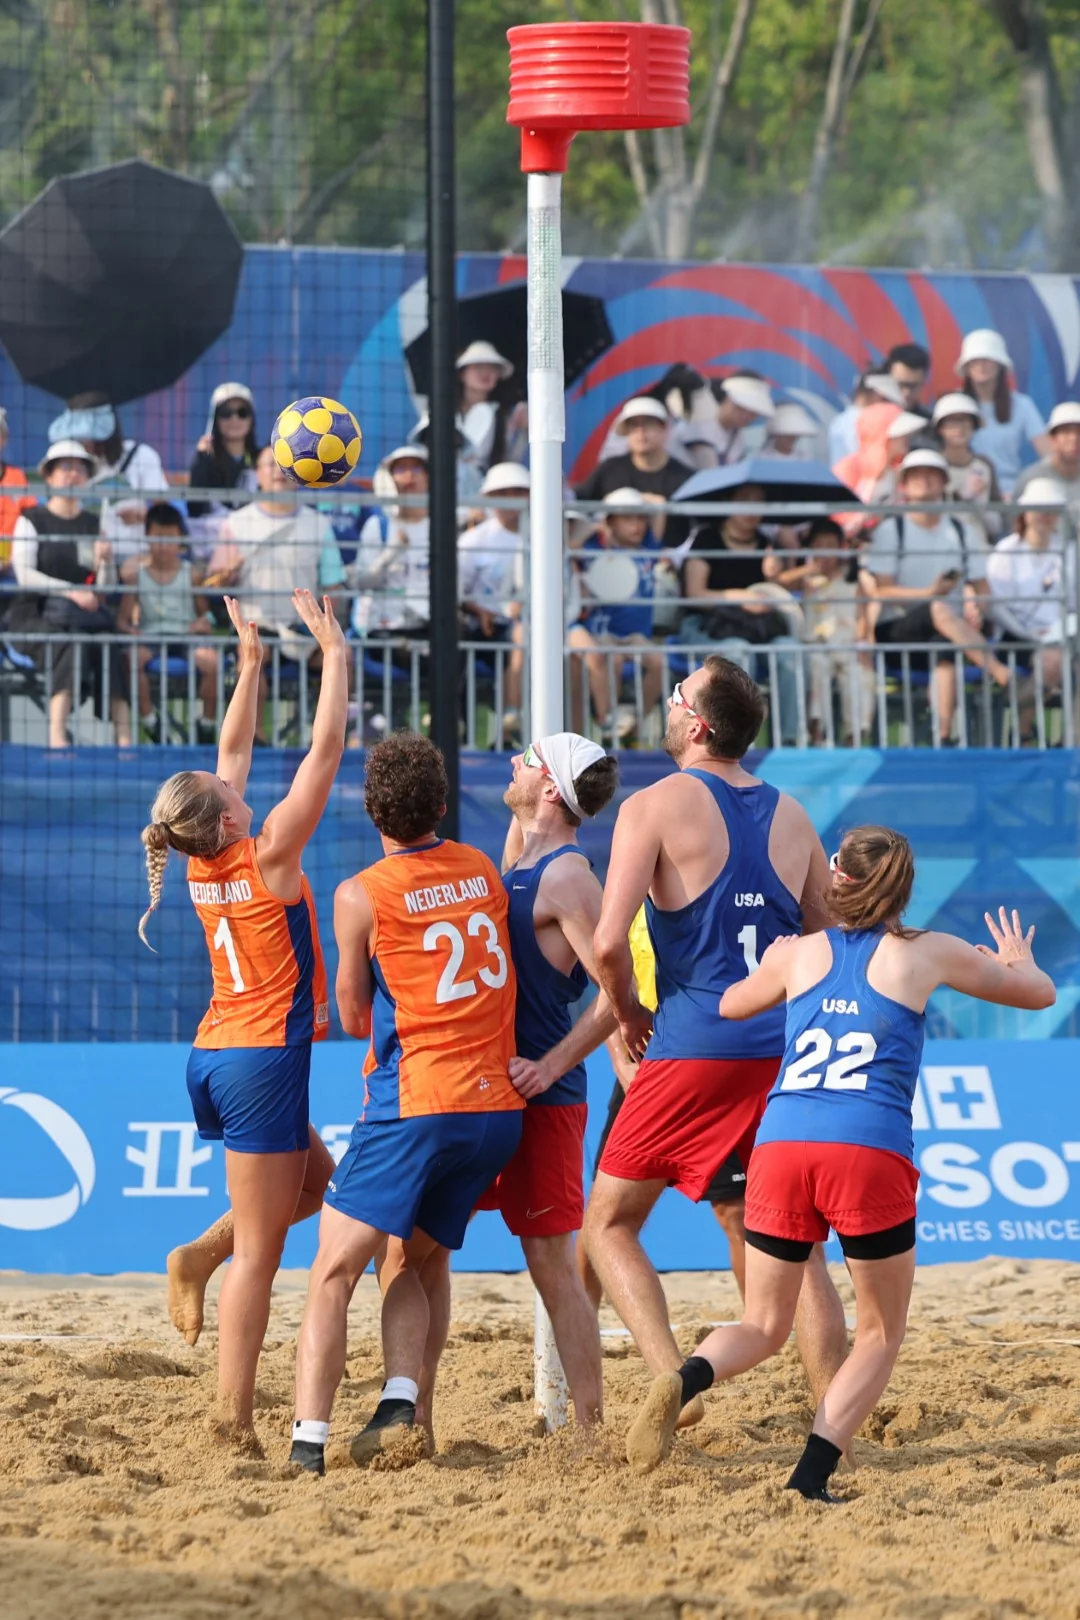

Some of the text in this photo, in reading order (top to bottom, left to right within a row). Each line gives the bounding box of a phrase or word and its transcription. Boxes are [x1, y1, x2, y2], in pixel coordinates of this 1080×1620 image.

[403, 876, 489, 914] NEDERLAND
[735, 893, 765, 907] USA
[214, 917, 245, 993] 1
[423, 912, 508, 1004] 23
[737, 925, 761, 979] 1
[822, 999, 859, 1015] USA
[780, 1027, 877, 1091] 22
[998, 1219, 1080, 1241] SINCE
